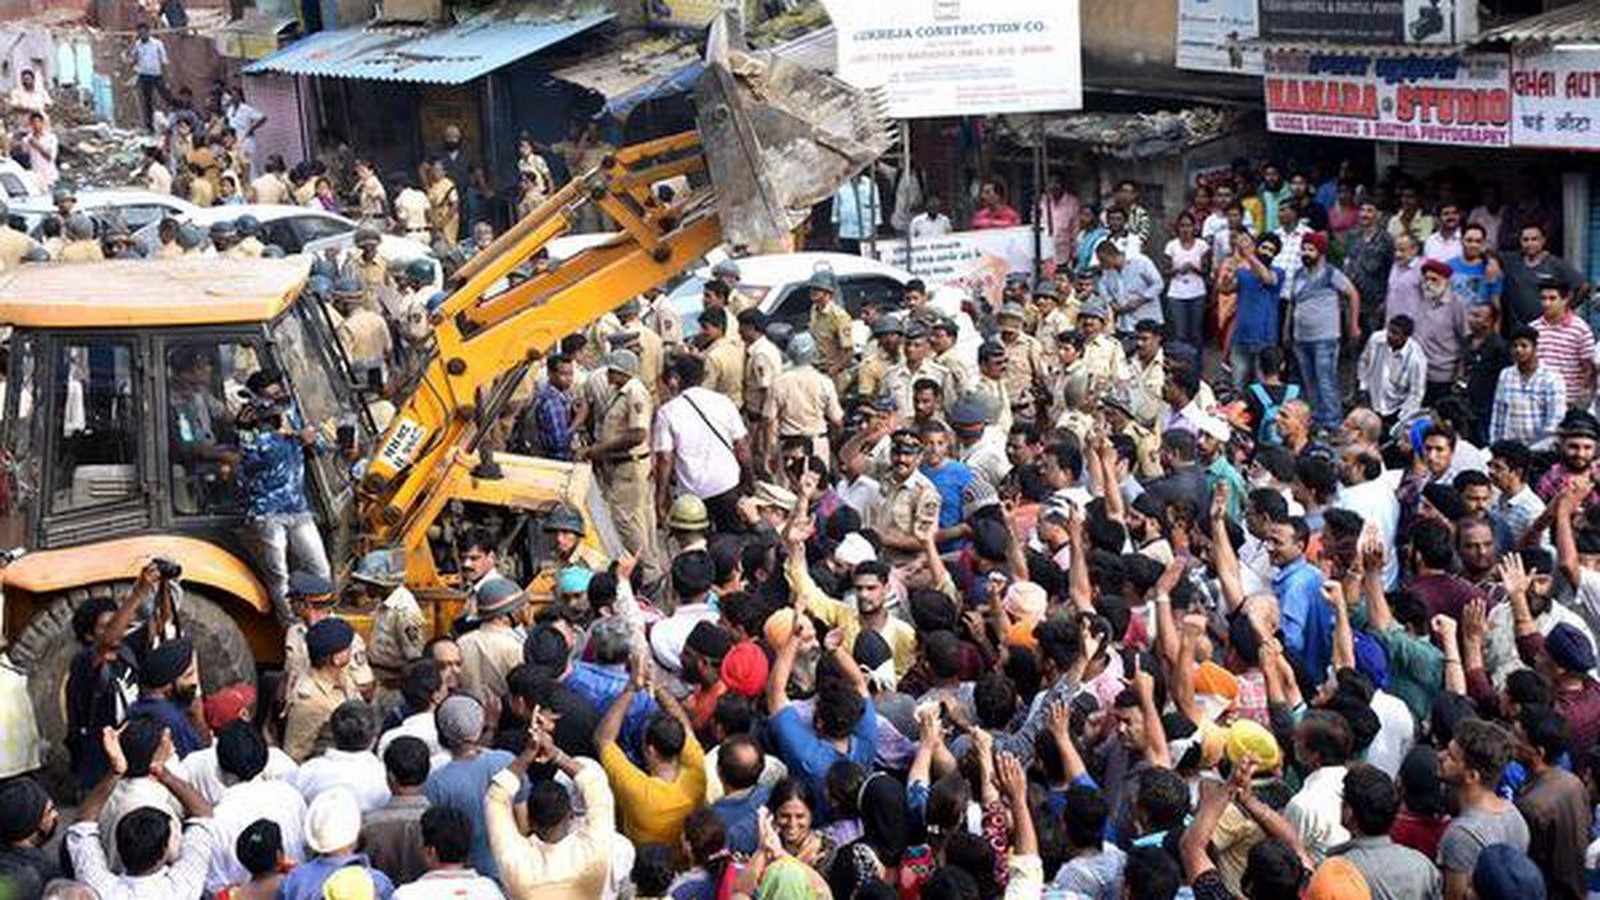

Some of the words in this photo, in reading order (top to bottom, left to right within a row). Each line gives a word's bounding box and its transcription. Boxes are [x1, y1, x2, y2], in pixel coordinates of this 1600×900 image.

[916, 22, 1020, 39] CONSTRUCTION
[1513, 69, 1555, 97] GHAI
[1267, 77, 1379, 121] HAMARA
[1396, 84, 1511, 126] STUDIO
[1420, 125, 1507, 145] PHOTOGRAPHY
